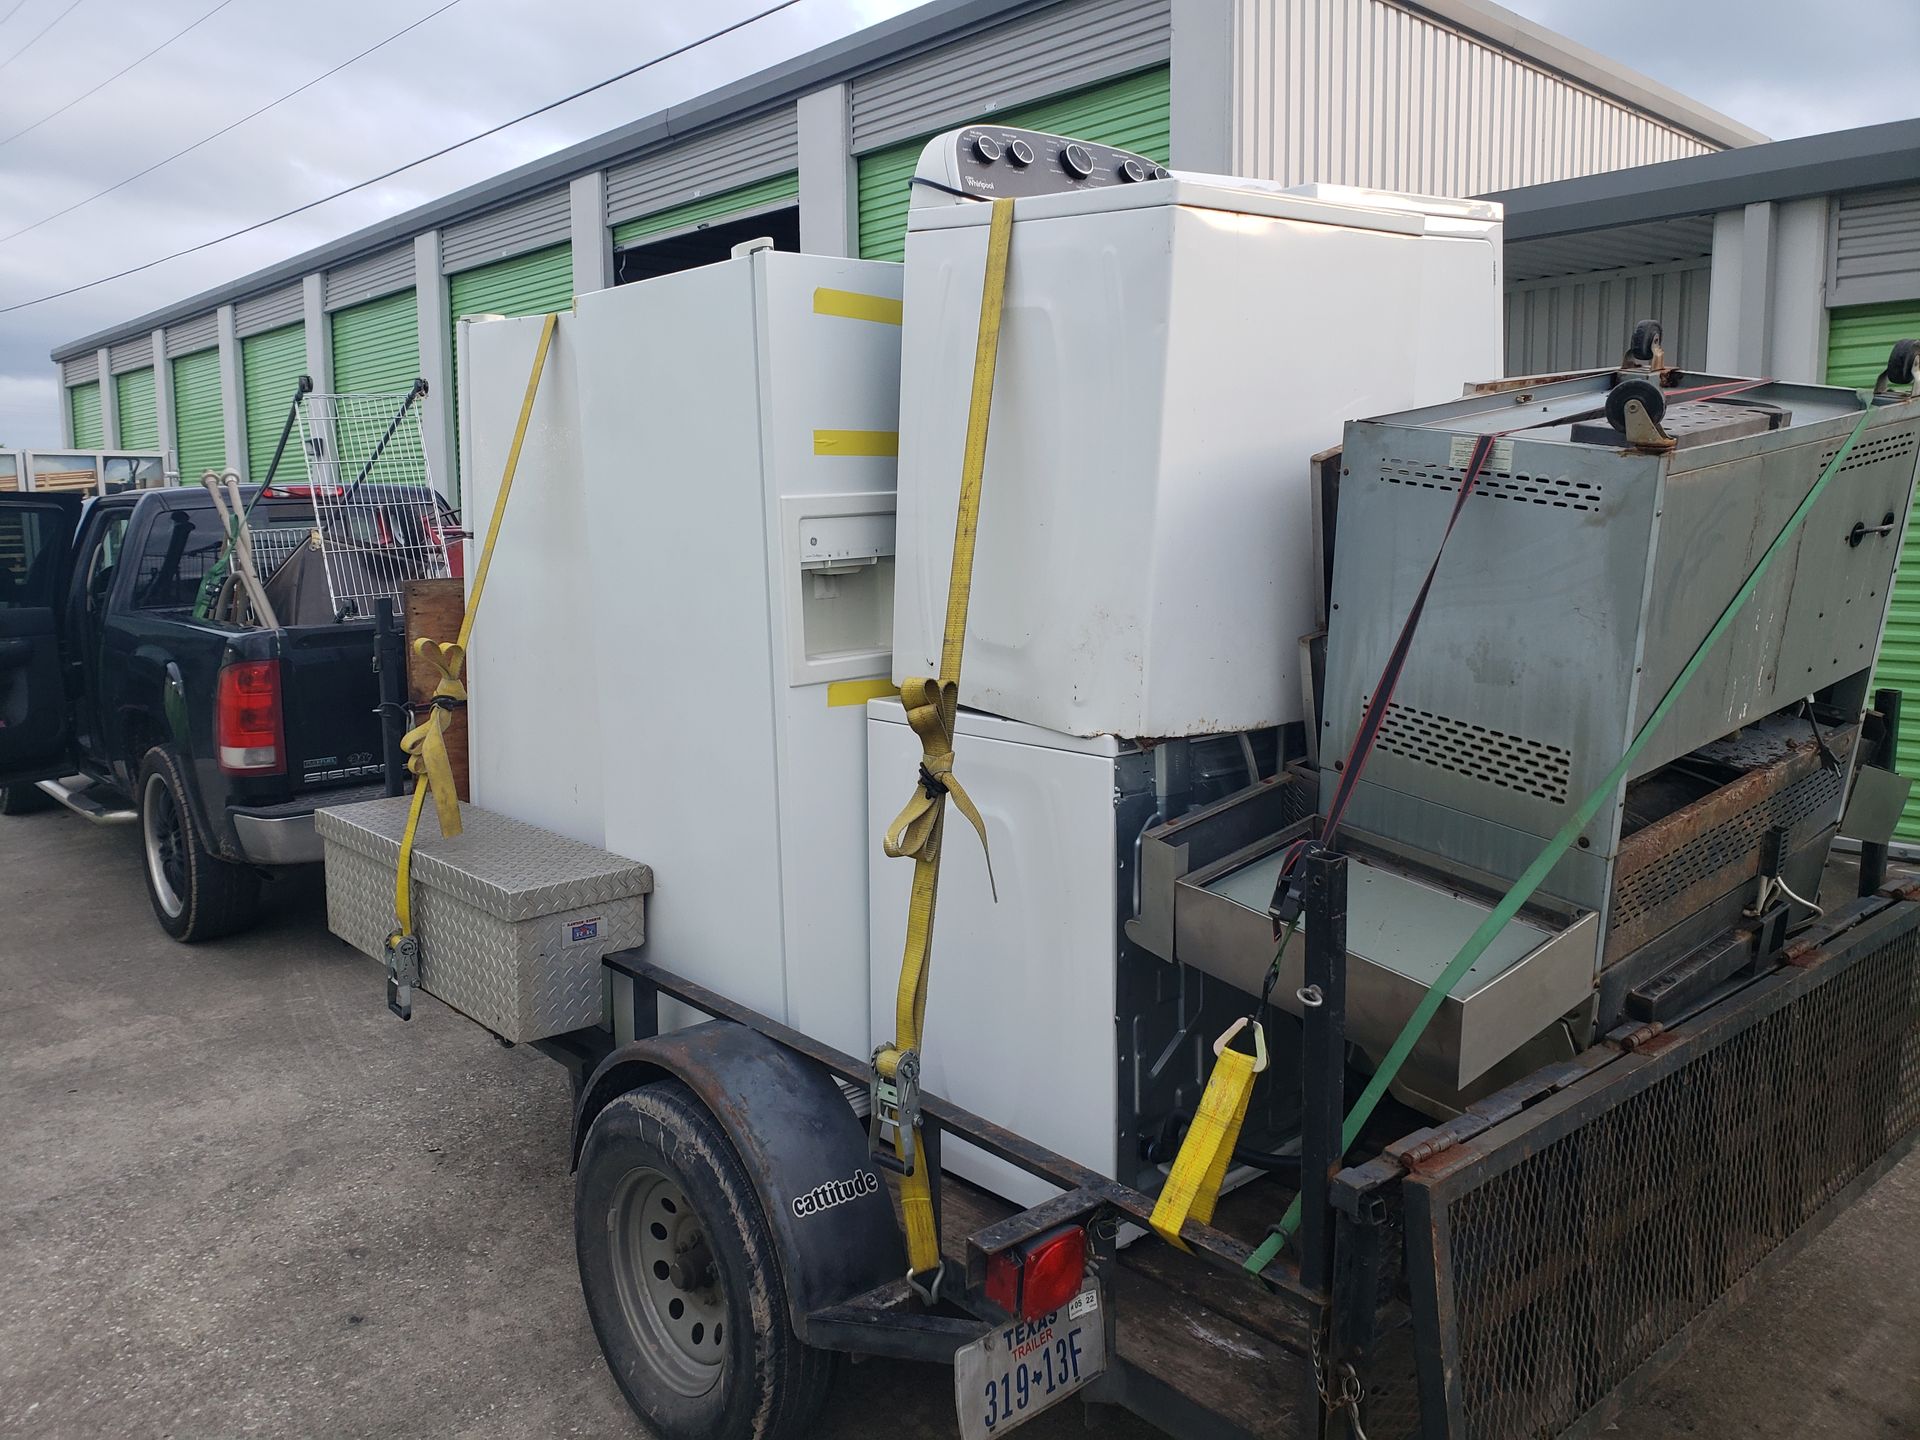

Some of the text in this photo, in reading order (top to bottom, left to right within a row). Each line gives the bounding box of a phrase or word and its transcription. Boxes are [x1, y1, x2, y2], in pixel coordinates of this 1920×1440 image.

[966, 178, 995, 190] Whirlpool
[793, 1169, 879, 1217] cattitude
[1074, 1299, 1083, 1309] 05
[1085, 1295, 1095, 1304] 22
[1003, 1311, 1058, 1351] TEXAS
[1011, 1328, 1054, 1362] TRAILER
